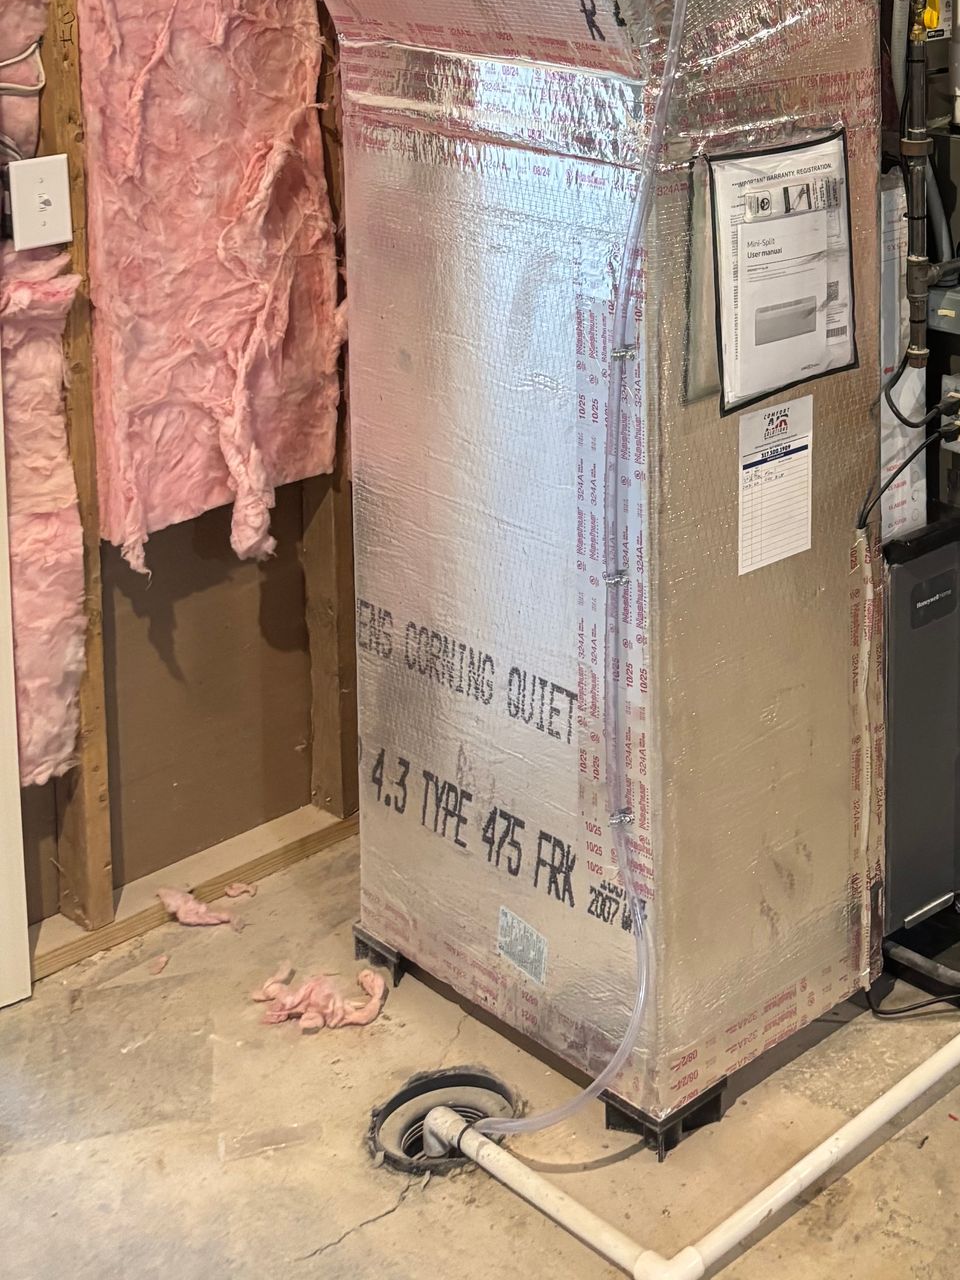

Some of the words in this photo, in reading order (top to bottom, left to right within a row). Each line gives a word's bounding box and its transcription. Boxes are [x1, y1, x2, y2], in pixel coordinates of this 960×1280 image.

[656, 184, 680, 197] 324A
[747, 237, 776, 249] Mini-Split
[747, 250, 762, 259] User
[761, 247, 783, 257] manual
[763, 407, 790, 420] COMFORT
[636, 546, 644, 574] 324A
[916, 593, 940, 609] Honeywell
[591, 636, 599, 665] 324A
[403, 621, 496, 706] CORNING
[507, 666, 579, 746] QUIET
[626, 662, 634, 688] 10/25
[639, 668, 648, 694] 10/25
[580, 748, 588, 773] 10/25
[639, 746, 647, 775] 324A
[422, 770, 472, 849] TYPE
[481, 806, 526, 877] 475
[533, 829, 576, 908] FRK
[585, 821, 602, 837] 10/25
[586, 841, 603, 857] 10/25
[587, 860, 604, 875] 10/25
